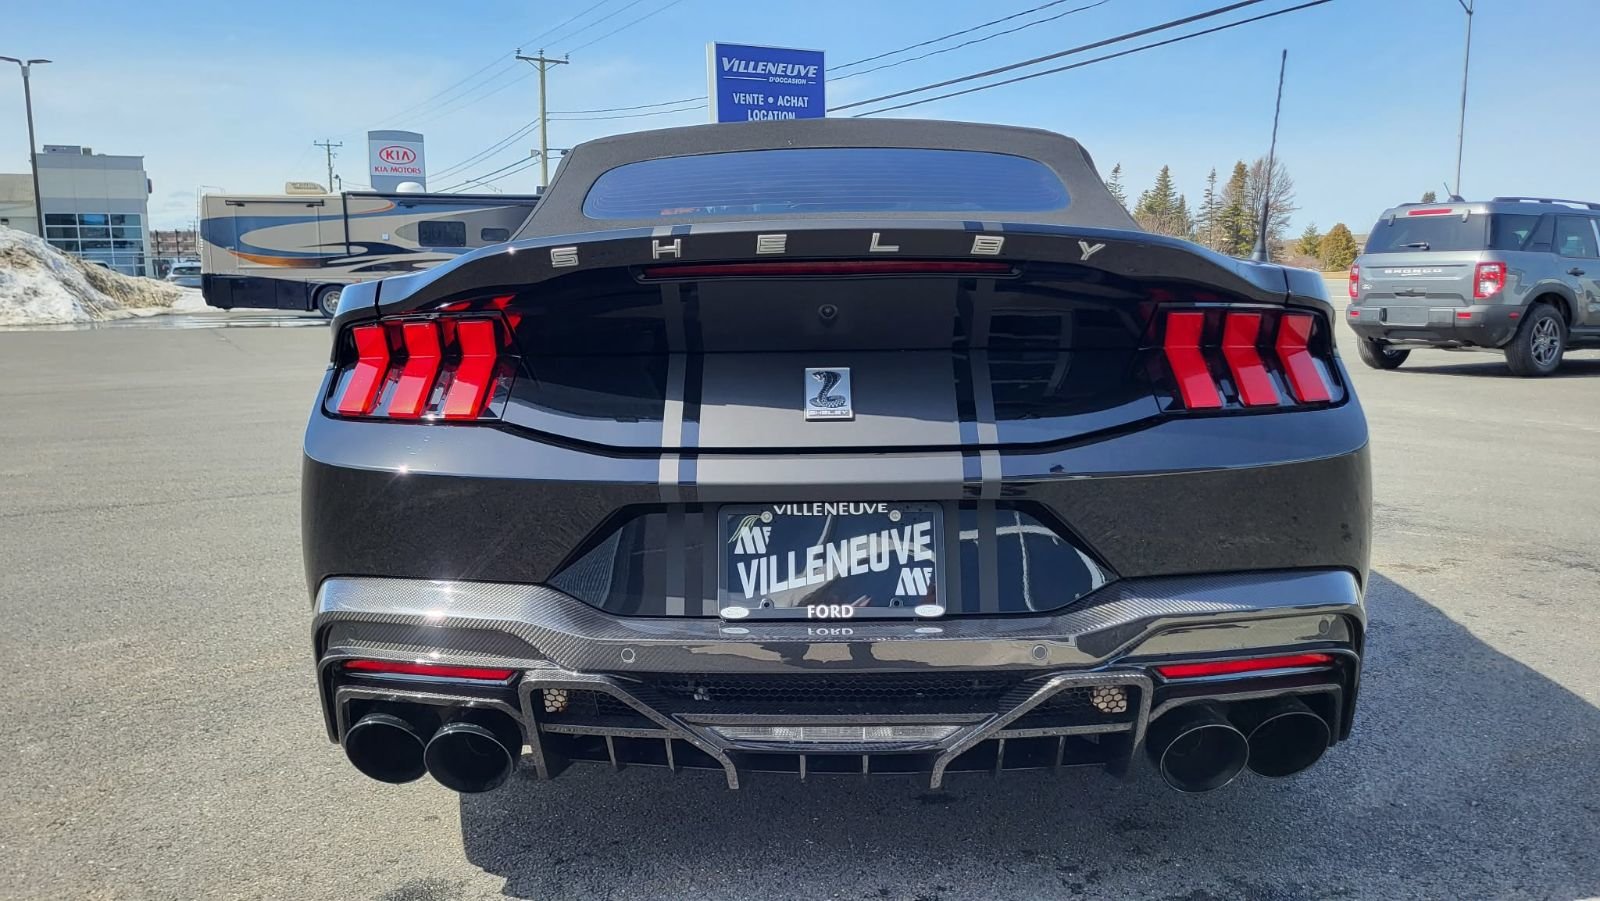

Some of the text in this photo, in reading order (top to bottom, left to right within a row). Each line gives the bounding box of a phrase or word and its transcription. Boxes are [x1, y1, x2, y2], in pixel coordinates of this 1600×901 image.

[722, 57, 818, 78] VILLENEUVE
[769, 76, 807, 85] D'OCCASION
[733, 93, 809, 108] VENTE ACHAT
[748, 109, 796, 122] LOCATION
[385, 150, 411, 161] KIA
[390, 166, 422, 174] MOTORS
[550, 232, 1106, 269] SHELBY
[773, 502, 888, 516] VILLENEUVE
[737, 520, 932, 599] VILLENEUVE
[807, 605, 854, 618] FORD
